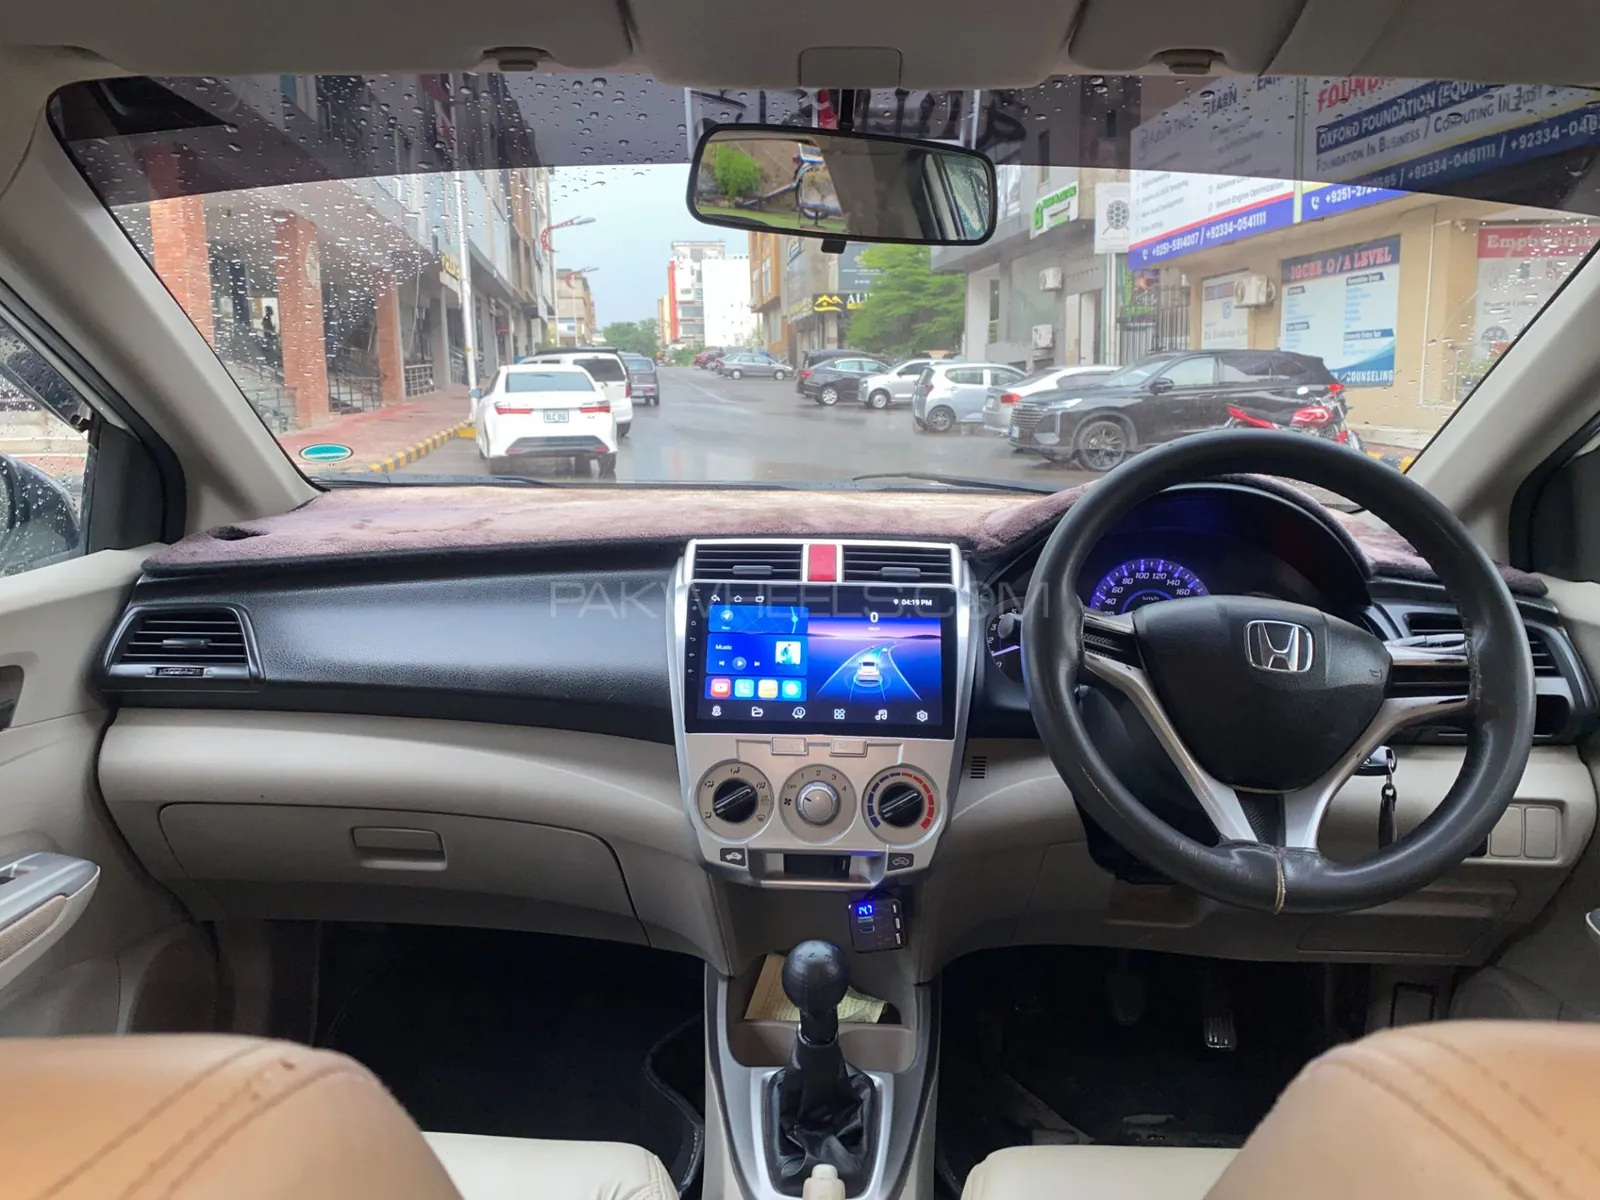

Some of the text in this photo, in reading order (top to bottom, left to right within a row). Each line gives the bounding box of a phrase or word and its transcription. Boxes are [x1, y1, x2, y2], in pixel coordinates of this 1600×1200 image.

[1320, 121, 1360, 149] OXFORD
[1362, 90, 1435, 134] FOUNDATION
[1354, 246, 1392, 268] LEVEL
[1136, 572, 1150, 580] 100
[1152, 572, 1167, 580] 120
[1166, 579, 1180, 587] 140
[1112, 586, 1124, 594] 60
[1176, 588, 1190, 596] 160
